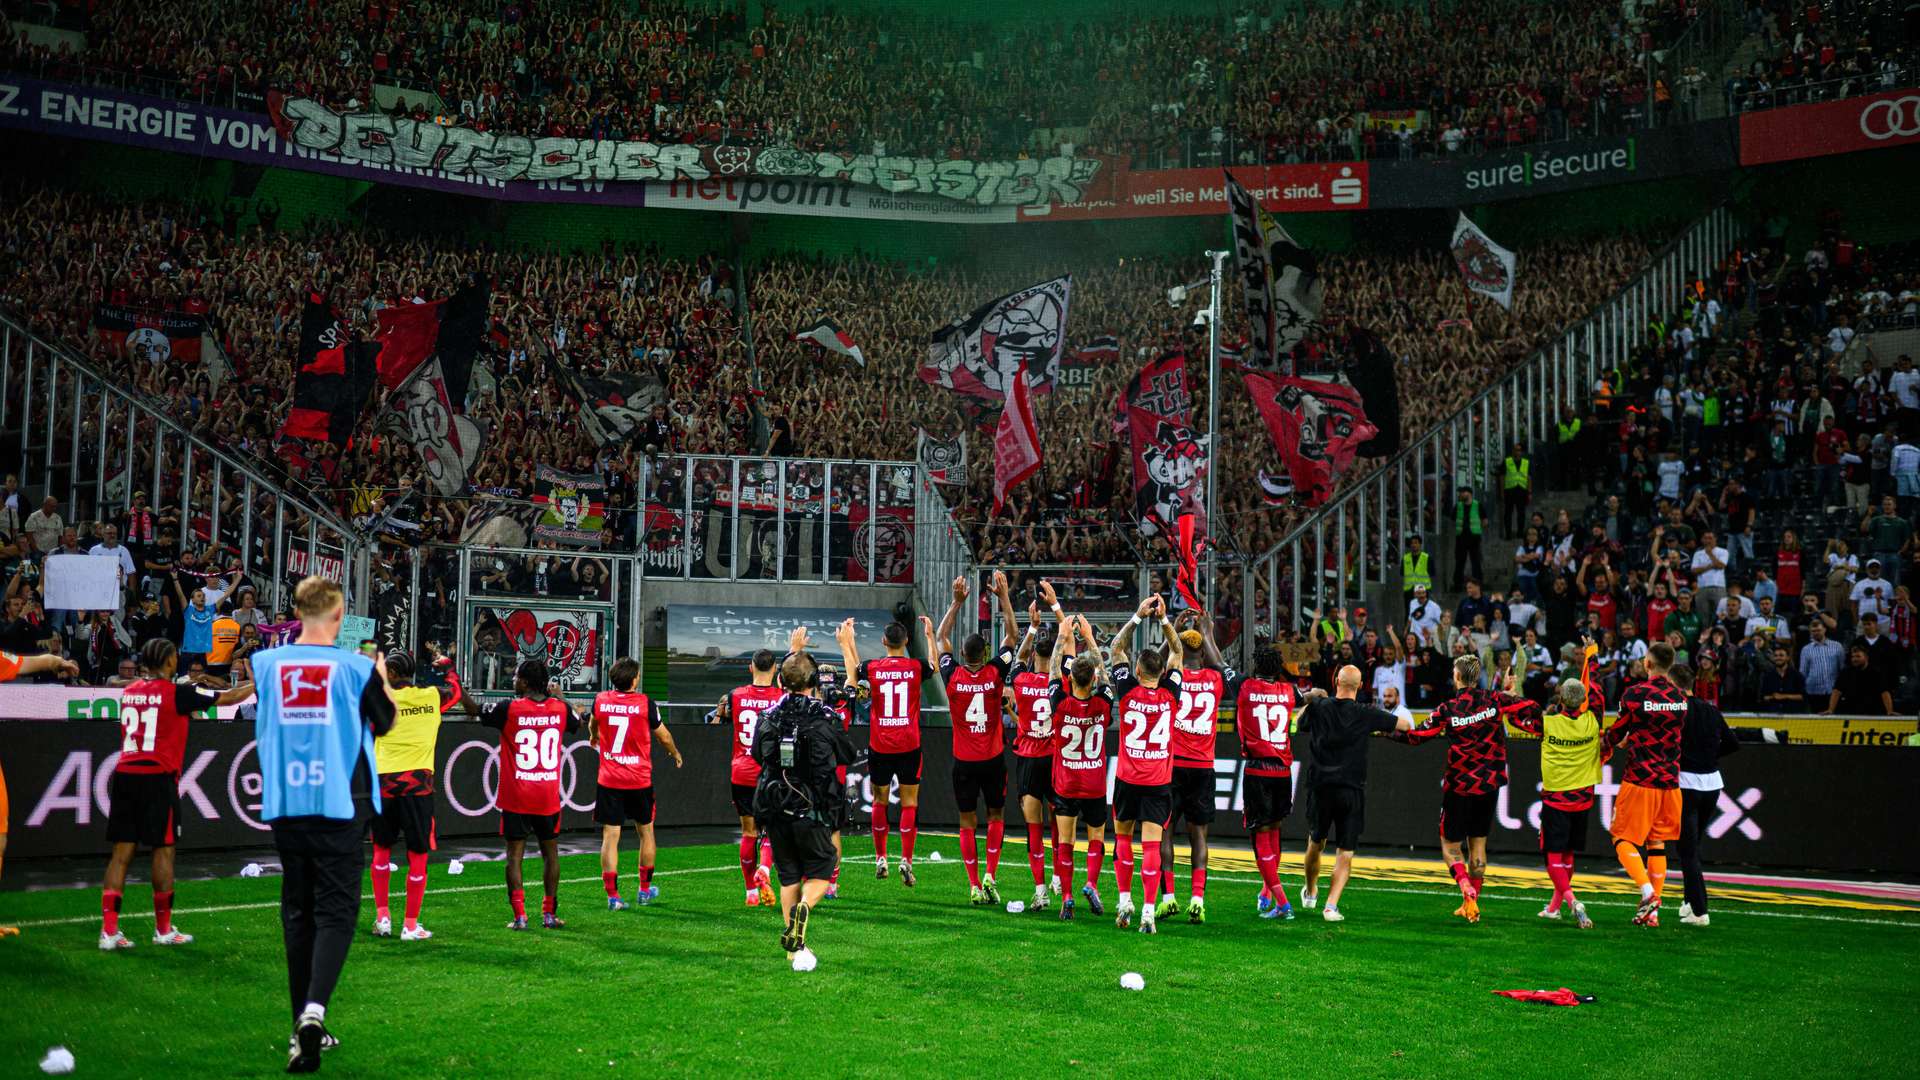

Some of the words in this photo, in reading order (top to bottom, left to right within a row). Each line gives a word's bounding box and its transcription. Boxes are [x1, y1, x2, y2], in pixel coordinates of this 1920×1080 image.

[40, 90, 196, 142] ENERGIE
[205, 116, 277, 152] VOM
[284, 97, 710, 182] DEUTSCHER
[1133, 189, 1165, 206] weil
[1169, 187, 1195, 204] Sie
[1284, 183, 1324, 200] sind.
[702, 626, 752, 636] die
[875, 671, 902, 680] BAYER
[903, 671, 914, 680] 04
[956, 683, 984, 693] BAYER
[984, 681, 995, 691] 04
[1181, 682, 1201, 692] AYER
[1202, 682, 1215, 691] 04
[148, 694, 162, 705] 04
[740, 698, 770, 709] BAYER
[880, 681, 909, 718] 11
[1127, 699, 1159, 714] BAYER
[1159, 702, 1171, 714] 04
[1249, 692, 1278, 703] BAYER
[1278, 693, 1289, 703] 04
[1644, 700, 1688, 712] Barmenia
[401, 703, 434, 717] menia
[600, 703, 627, 714] BAYER
[628, 704, 640, 714] 04
[965, 692, 988, 727] 4
[1175, 692, 1216, 726] 22
[1451, 707, 1497, 728] Barmenia
[518, 716, 550, 727] BAYER
[550, 714, 561, 725] 04
[738, 710, 758, 747] 3
[879, 717, 909, 727] TERRIER
[969, 724, 986, 734] TAH
[1063, 714, 1094, 726] BAYER
[1094, 714, 1105, 724] 04
[1252, 704, 1288, 743] 12
[121, 707, 158, 752] 21
[608, 716, 629, 753] 7
[1123, 710, 1172, 751] 24
[515, 728, 560, 770] 30
[1060, 724, 1104, 761] 20
[1548, 735, 1594, 748] Barmenia
[286, 760, 325, 787] 05
[23, 750, 222, 827] AK
